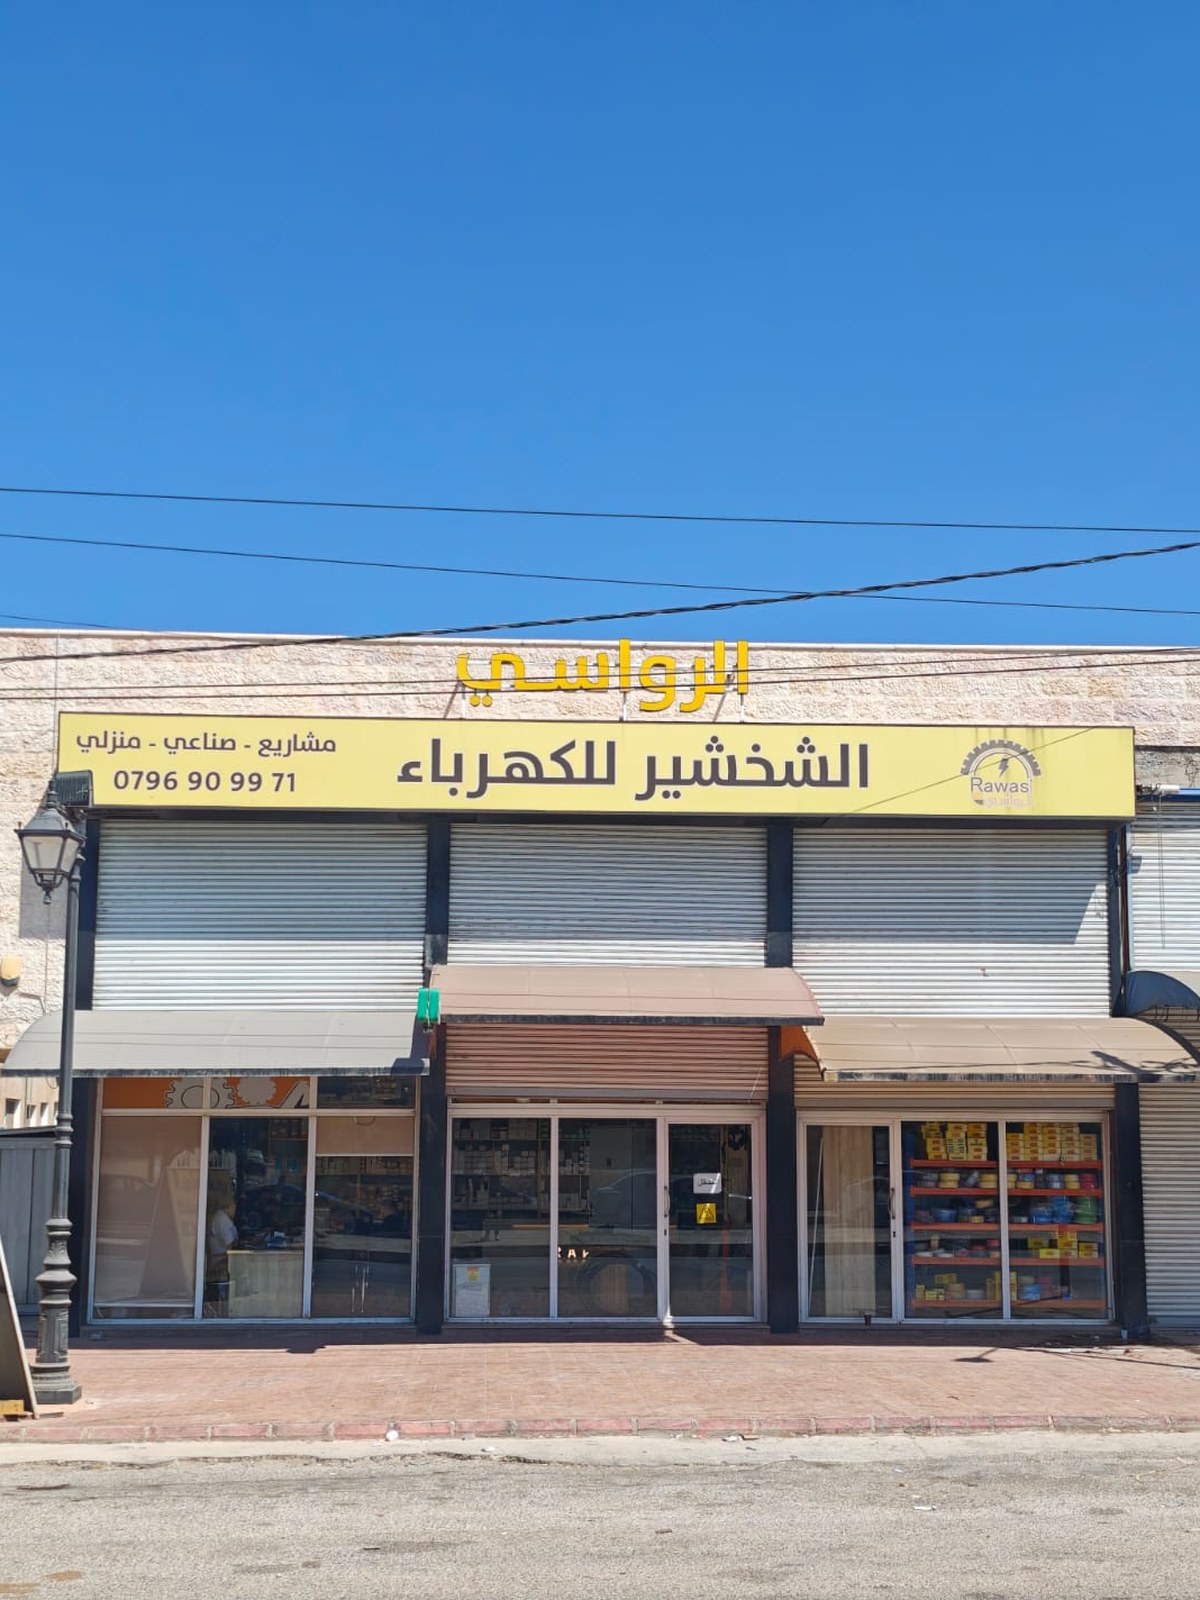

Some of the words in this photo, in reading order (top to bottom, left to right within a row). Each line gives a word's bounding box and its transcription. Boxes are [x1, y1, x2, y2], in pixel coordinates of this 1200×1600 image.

[457, 638, 749, 713] الرواسي
[76, 730, 141, 755] منزلي
[163, 731, 237, 755] صناعي
[257, 731, 336, 758] مشاريع
[113, 770, 178, 791] 0796
[187, 771, 221, 791] 90
[230, 772, 263, 792] 99
[271, 772, 295, 792] 71
[397, 738, 616, 799] للكهرباء
[634, 735, 869, 801] الشخشير
